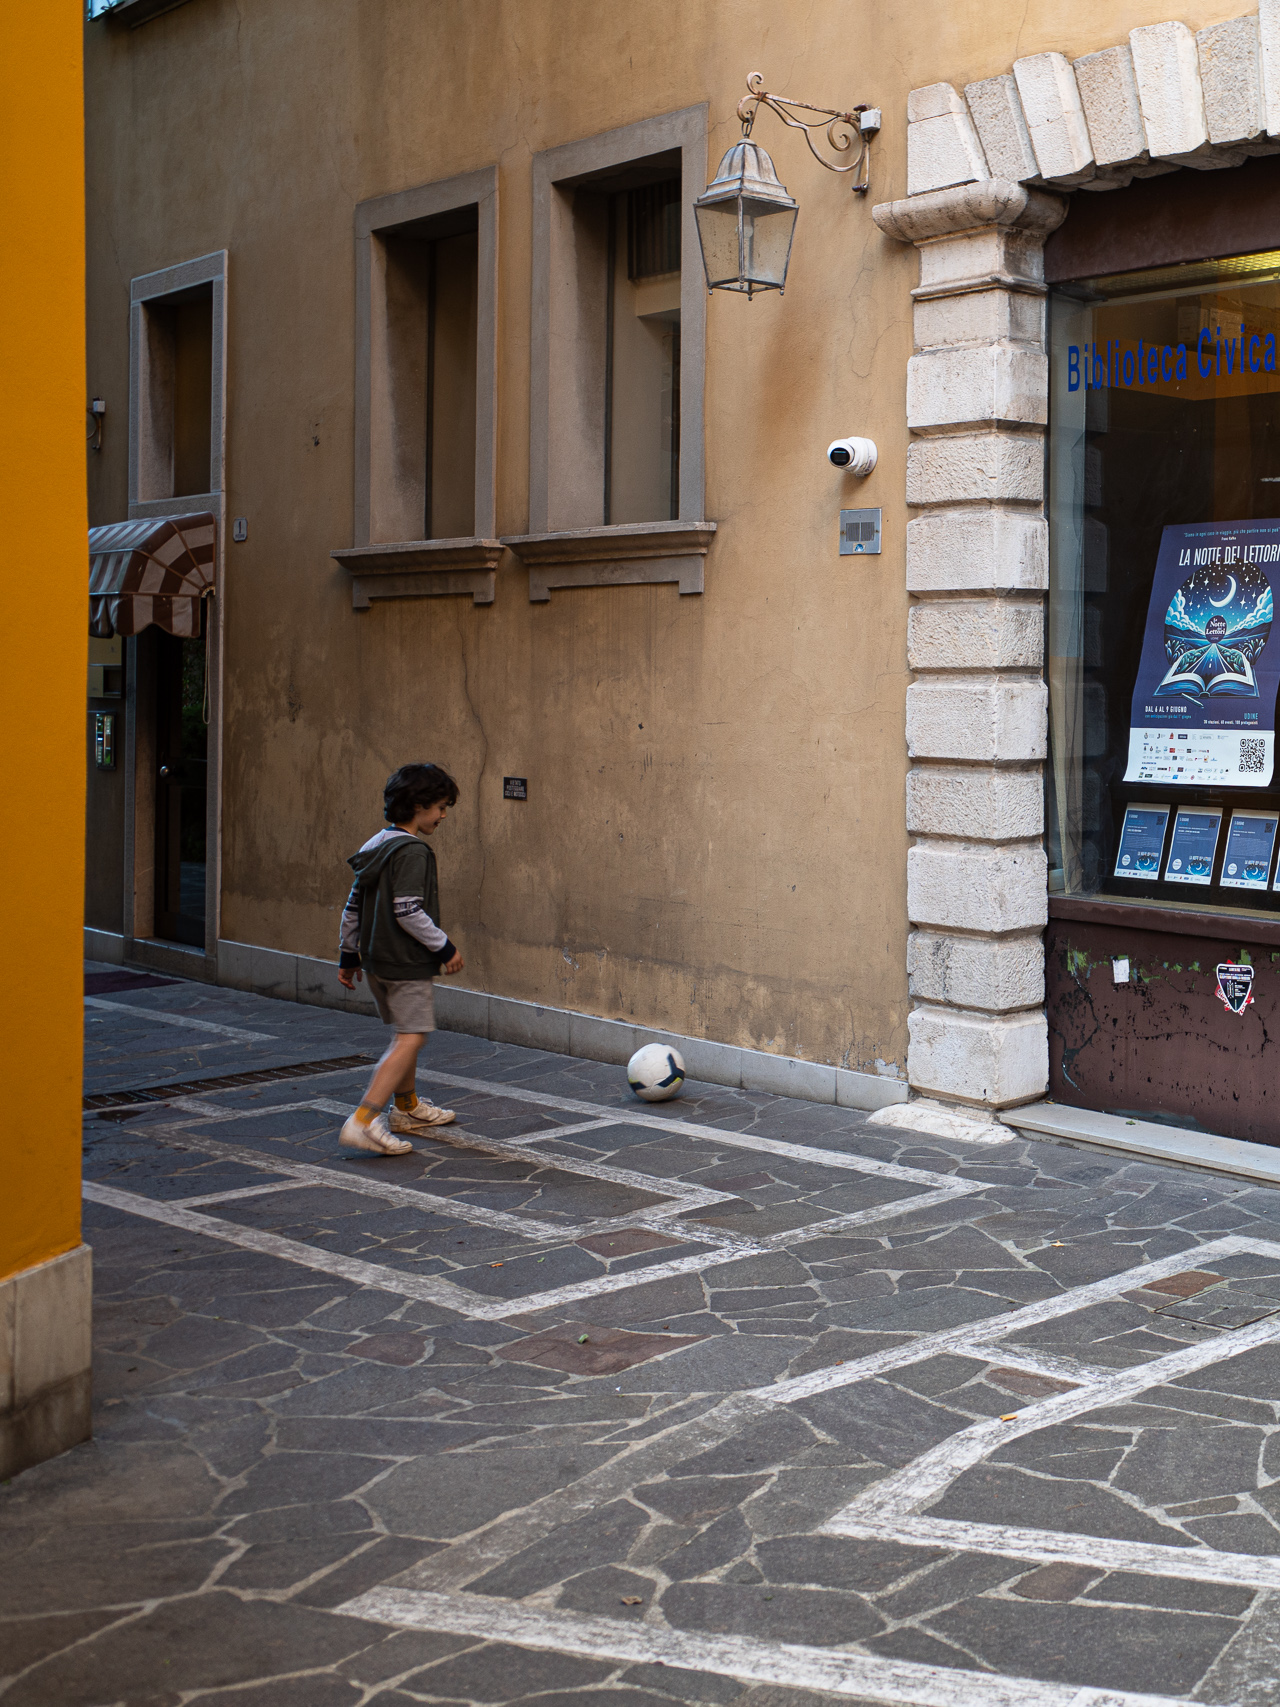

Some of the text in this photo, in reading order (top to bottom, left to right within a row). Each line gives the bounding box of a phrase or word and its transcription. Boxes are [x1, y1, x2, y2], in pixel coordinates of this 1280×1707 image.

[1068, 339, 1186, 392] Biblioteca
[1198, 324, 1276, 378] Civica
[1179, 549, 1190, 566] LA
[1194, 547, 1222, 565] NOTTE
[1223, 546, 1240, 564] DEI
